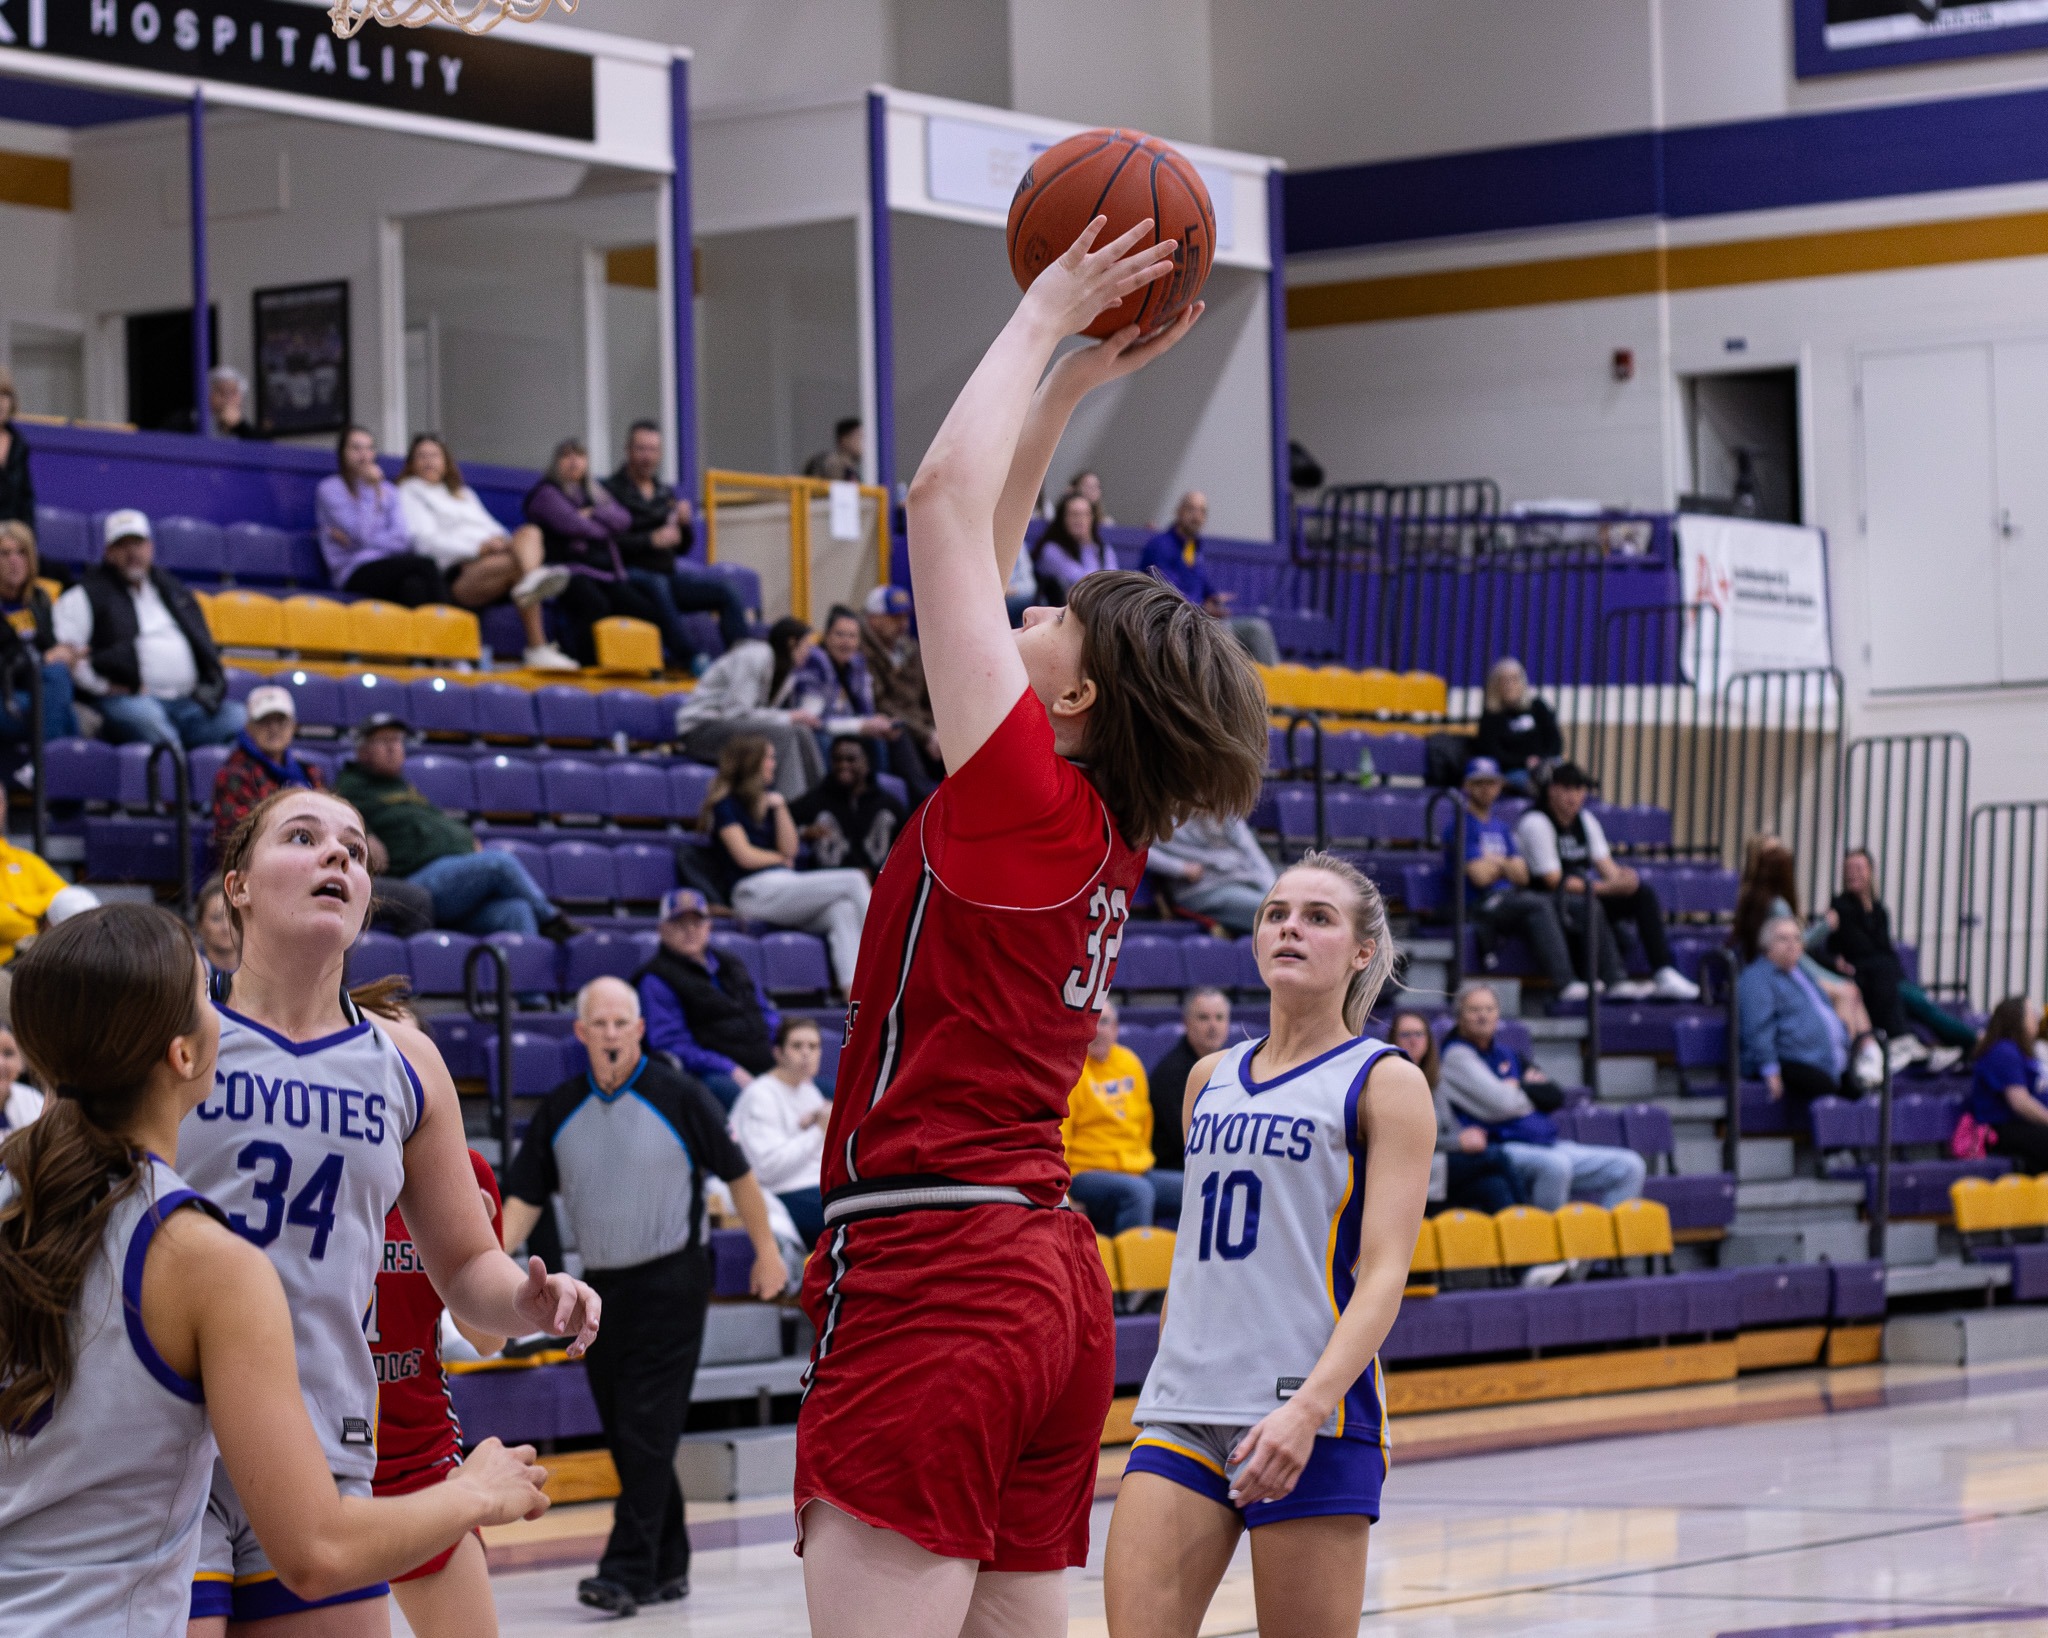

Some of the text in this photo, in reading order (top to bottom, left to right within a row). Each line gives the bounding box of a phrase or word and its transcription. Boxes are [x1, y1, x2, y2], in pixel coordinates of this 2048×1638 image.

[0, 0, 463, 96] I HOSPITALITY
[1063, 878, 1130, 1013] 32
[196, 1069, 387, 1147] COYOTES
[1184, 1112, 1317, 1163] OYOTES
[228, 1139, 345, 1262] 34
[1198, 1169, 1263, 1262] 10
